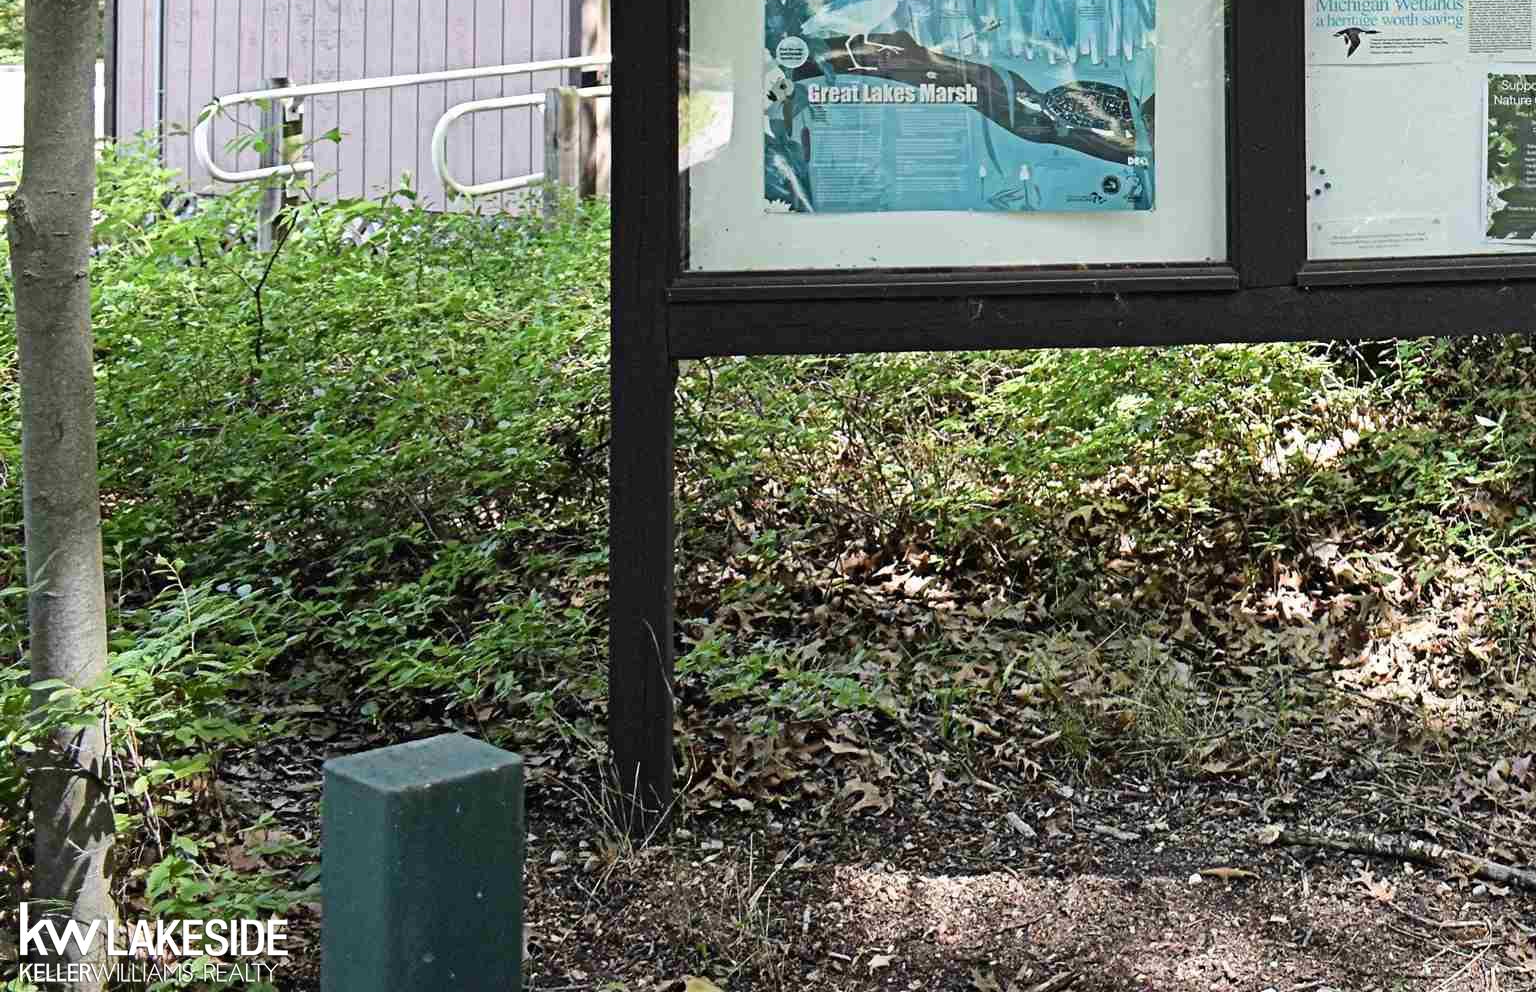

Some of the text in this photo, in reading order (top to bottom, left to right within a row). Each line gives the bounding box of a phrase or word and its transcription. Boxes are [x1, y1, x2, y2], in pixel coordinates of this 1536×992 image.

[1315, 11, 1465, 29] a heritage worth saving
[807, 82, 978, 104] Great Lakes Marsh
[1493, 94, 1532, 105] Nature
